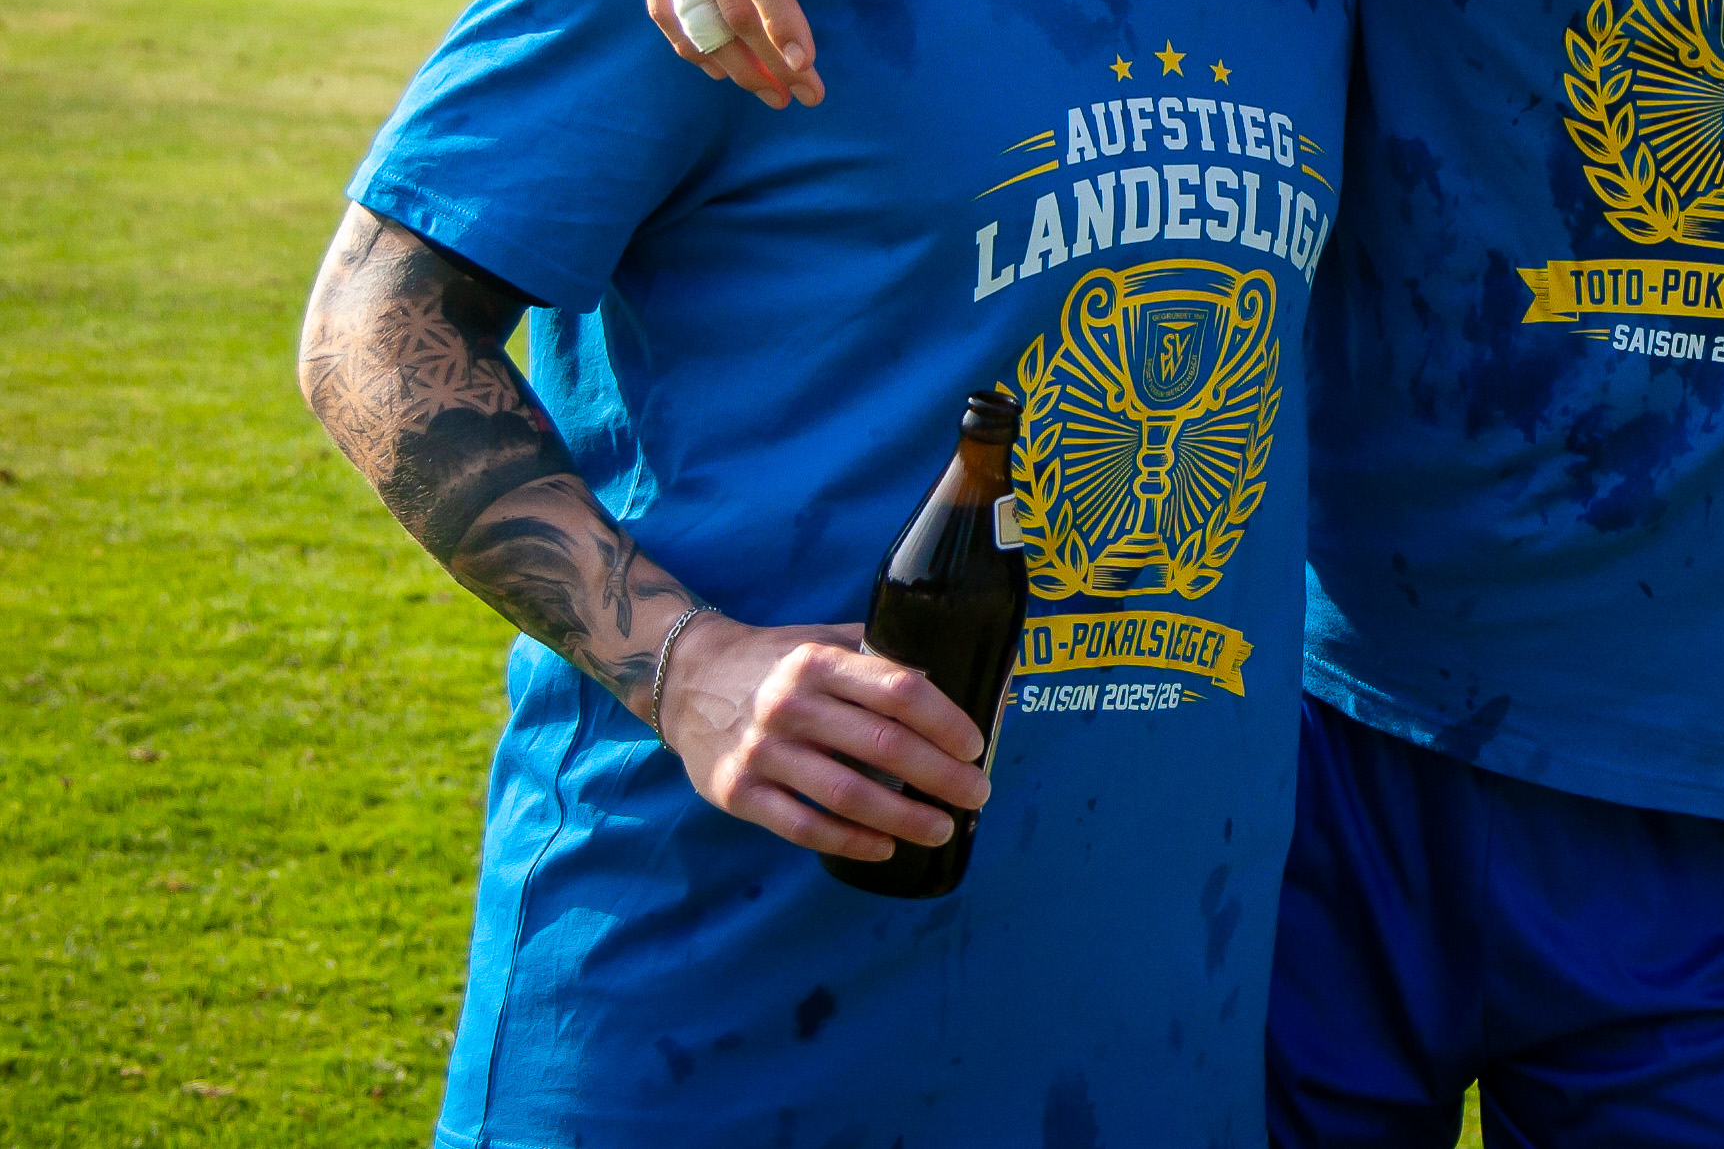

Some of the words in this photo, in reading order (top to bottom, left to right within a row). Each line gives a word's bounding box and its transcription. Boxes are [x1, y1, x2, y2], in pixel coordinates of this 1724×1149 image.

[1066, 97, 1296, 168] AUFSTIEG
[974, 163, 1329, 303] LANDESLIGA
[1612, 324, 1706, 361] SAISON
[1018, 619, 1226, 669] TO-POKALSIEGER
[1021, 684, 1099, 712] SAISON
[1102, 682, 1182, 711] 2025/26
